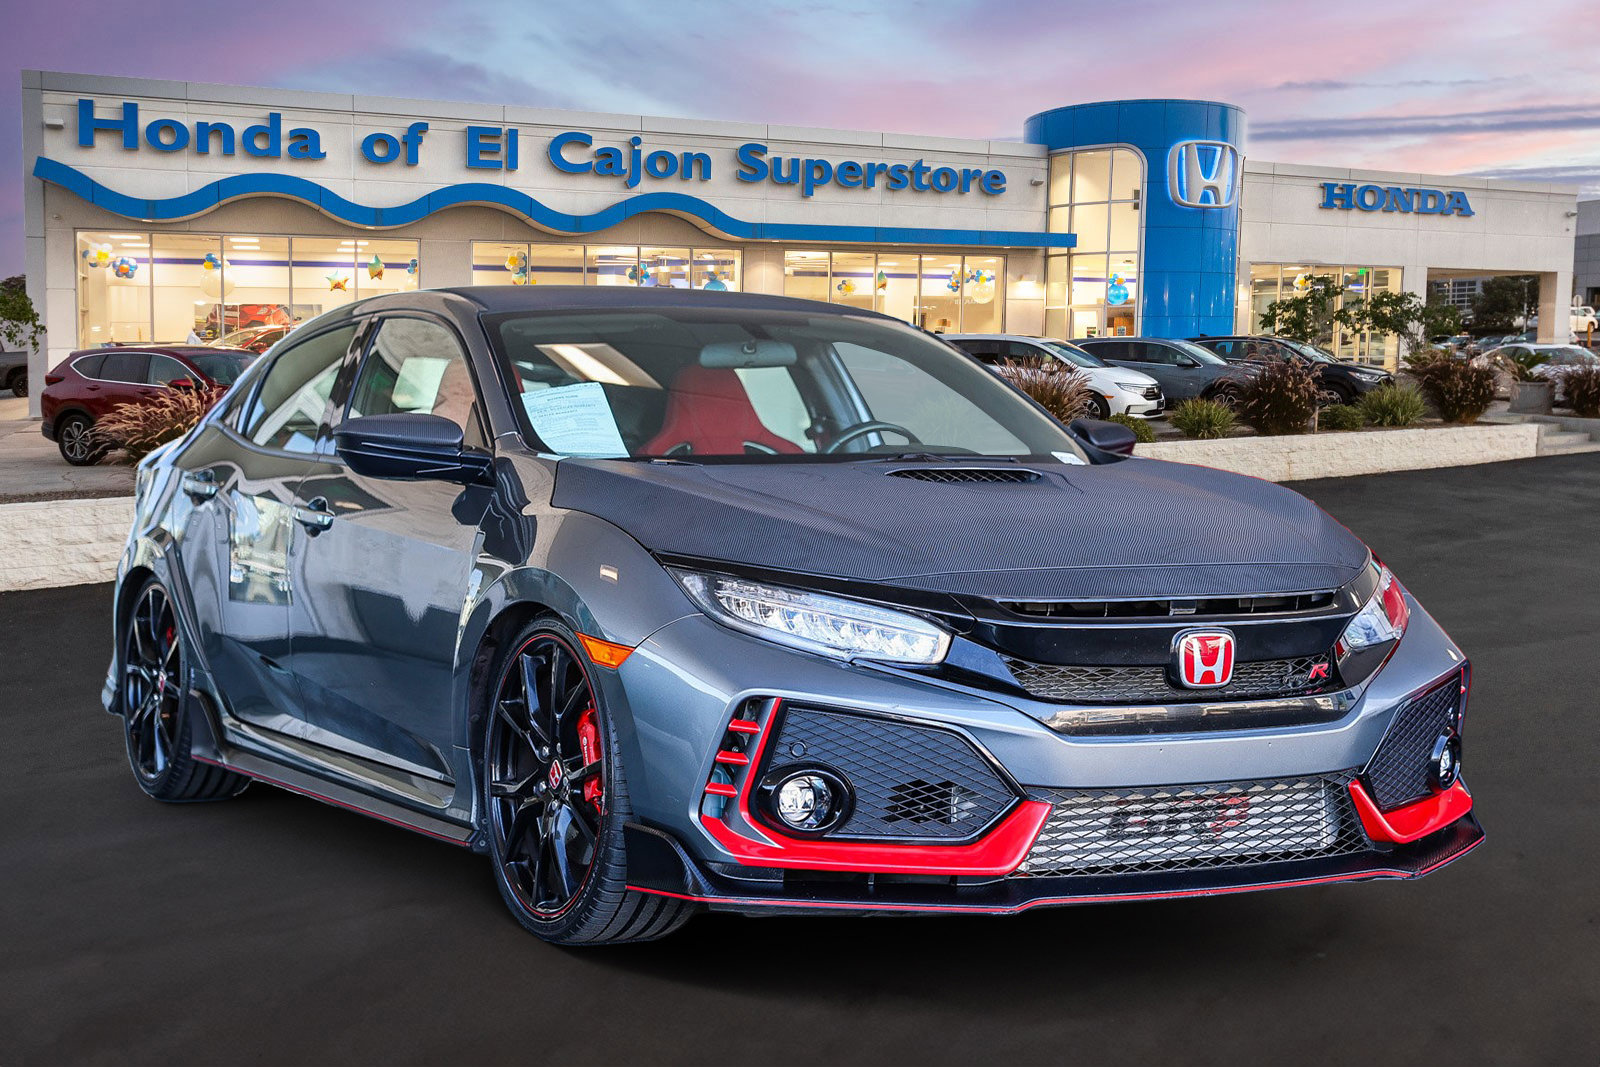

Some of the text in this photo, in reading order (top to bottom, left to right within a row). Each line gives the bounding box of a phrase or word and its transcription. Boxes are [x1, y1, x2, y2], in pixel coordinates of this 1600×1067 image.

[78, 98, 1007, 197] Honda of El Cajon Superstore
[1319, 182, 1475, 216] HONDA
